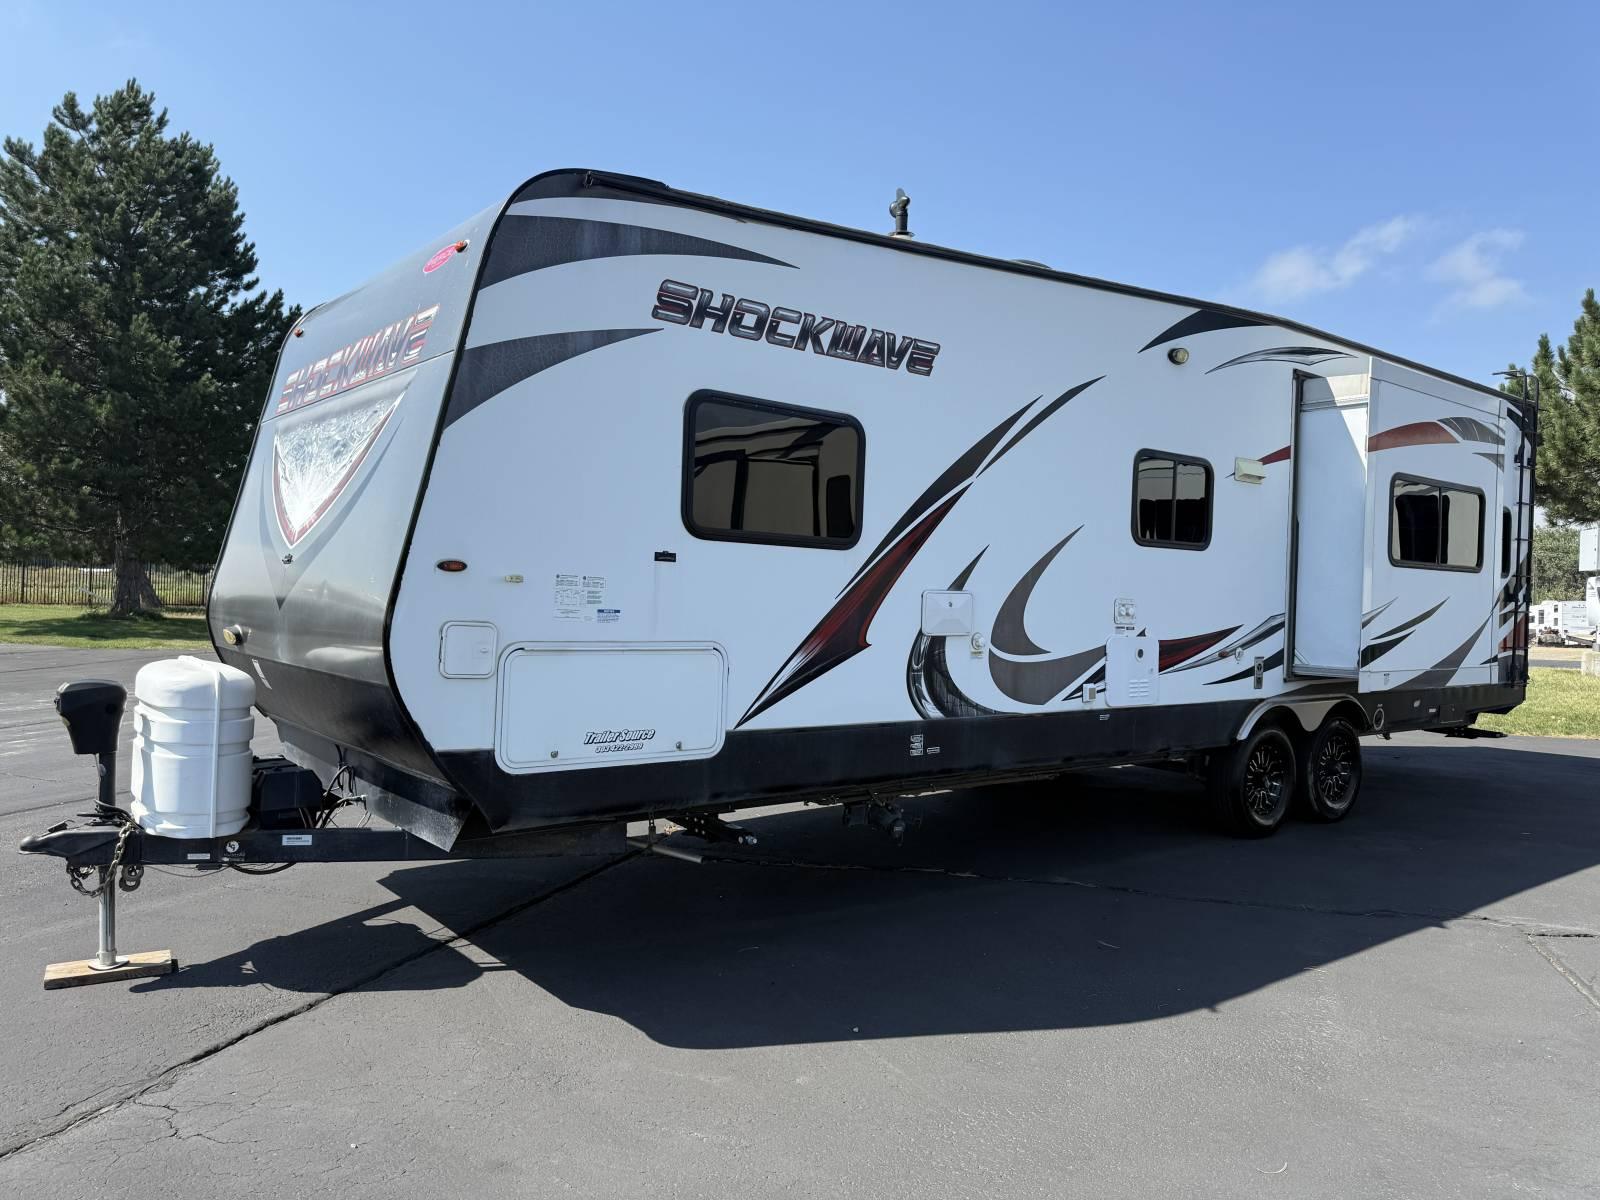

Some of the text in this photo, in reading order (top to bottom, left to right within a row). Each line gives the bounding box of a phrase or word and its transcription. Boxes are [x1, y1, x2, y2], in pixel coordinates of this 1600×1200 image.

[276, 304, 441, 415] SHOCKWAVE
[651, 278, 941, 377] SHOCKWAVE
[584, 728, 656, 745] Trailer Source
